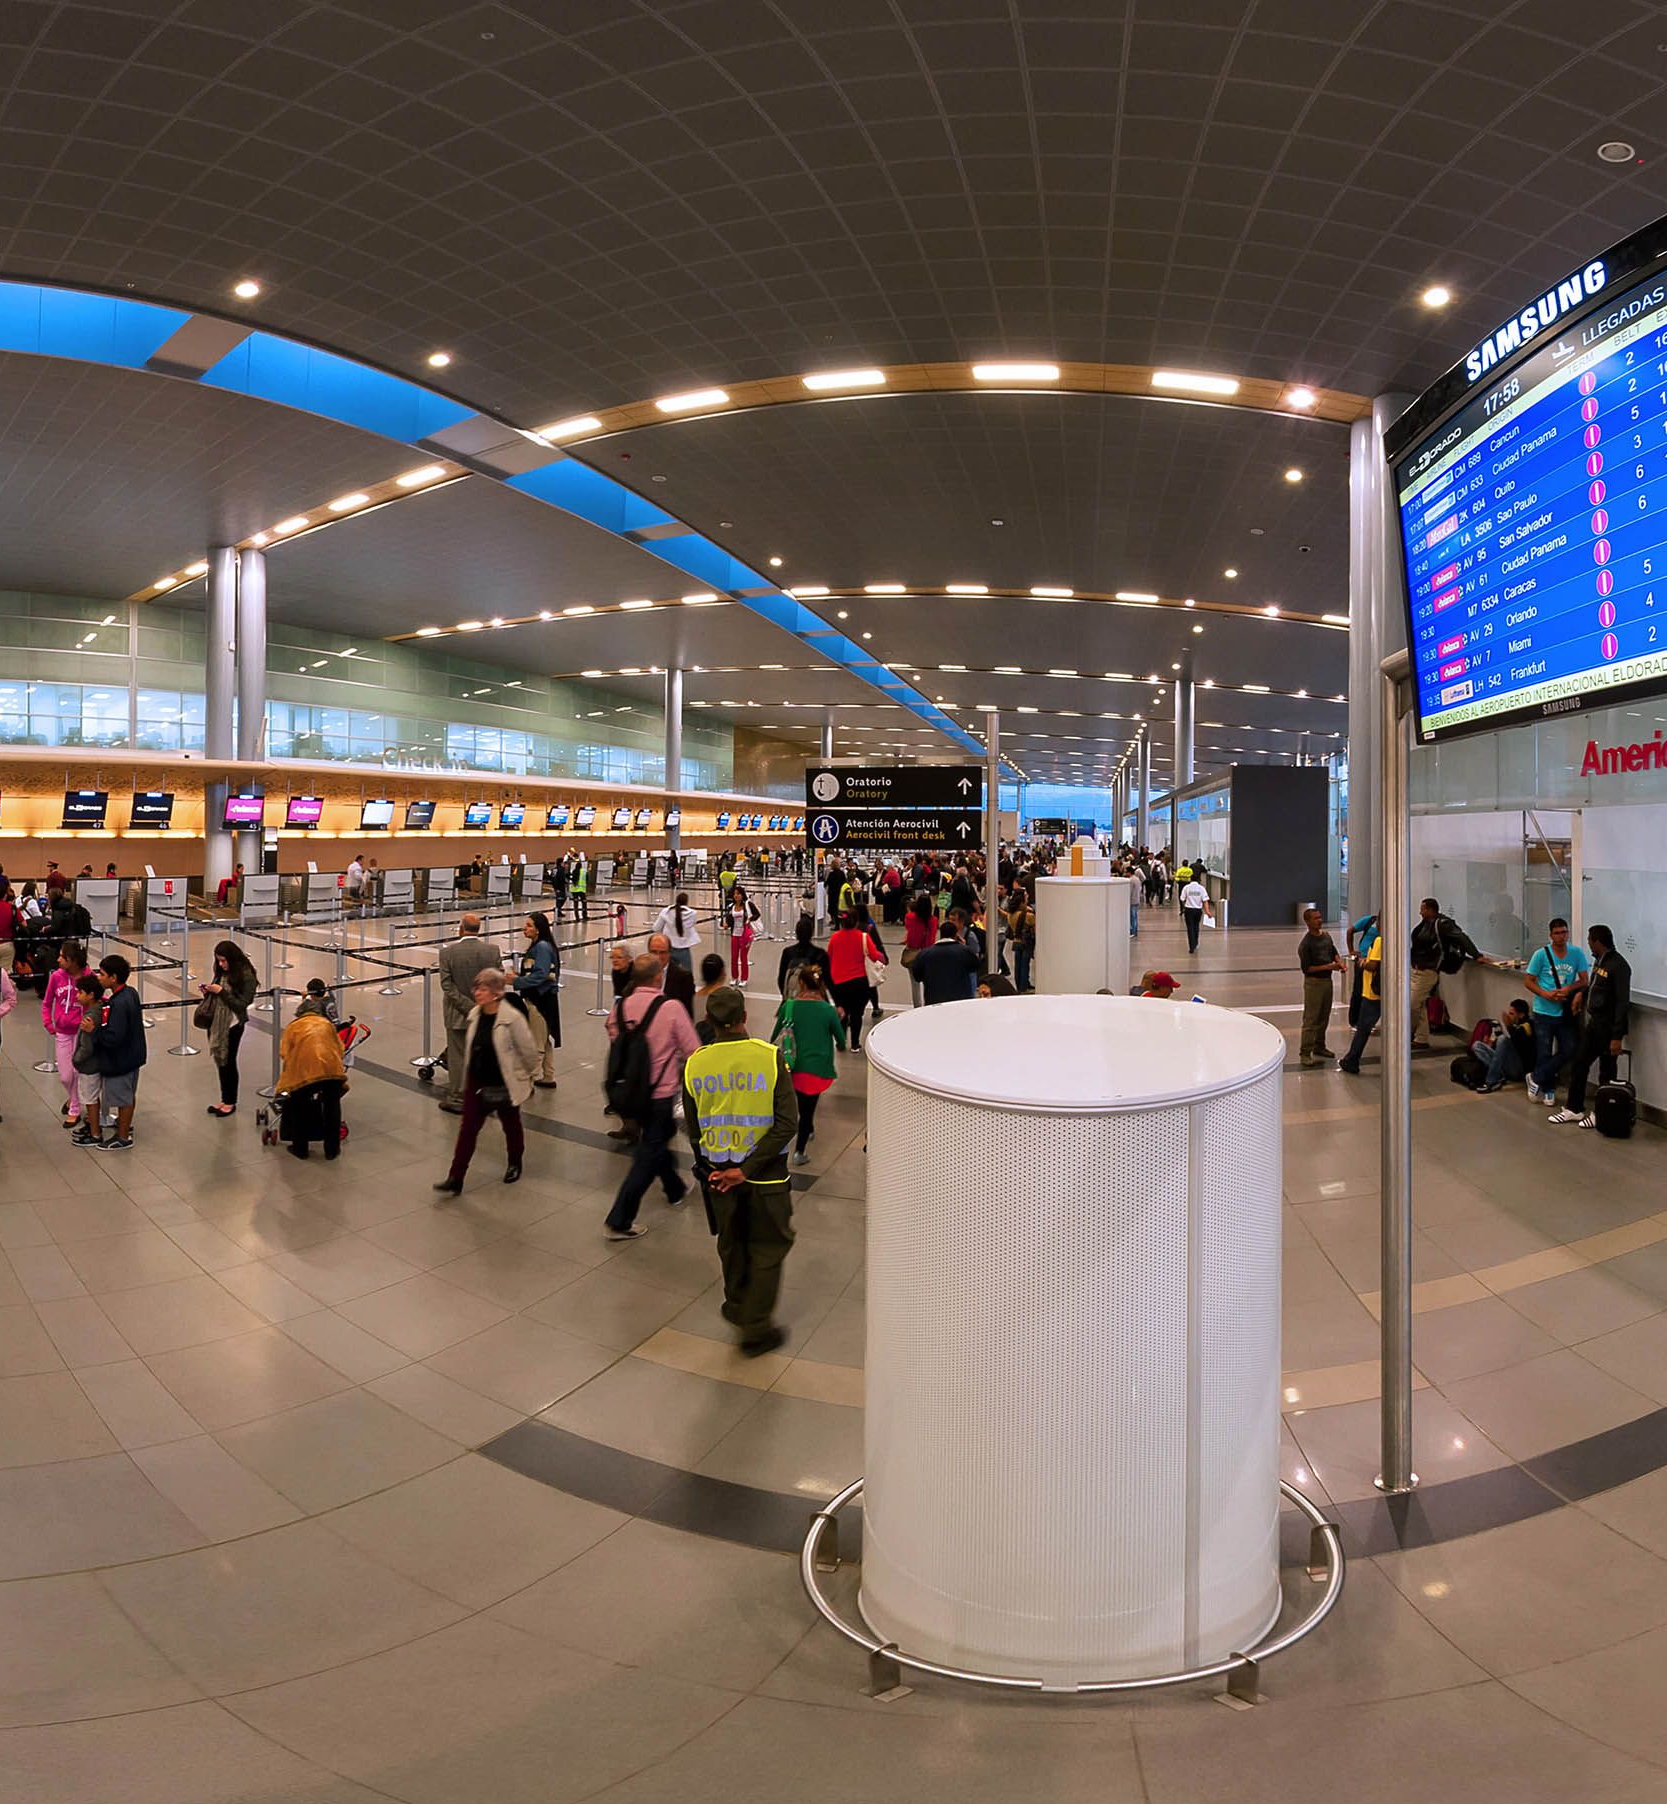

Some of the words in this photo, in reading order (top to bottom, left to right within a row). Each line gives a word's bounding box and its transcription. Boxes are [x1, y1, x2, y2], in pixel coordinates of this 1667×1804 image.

[1467, 261, 1606, 381] SAMSUNG
[1484, 378, 1519, 416] 17:58
[1582, 286, 1665, 346] LLEGADAS
[1490, 426, 1520, 452] Cancun
[1521, 427, 1558, 457] Panama
[1495, 479, 1515, 500] Quito
[1516, 511, 1554, 539] Salvador
[1504, 577, 1537, 601] Caracas
[1510, 660, 1546, 681] Frankfurt
[1533, 673, 1610, 701] INTERNACIONAL
[846, 777, 892, 787] Oratorio
[846, 789, 888, 800] Oratory
[846, 818, 890, 829] Atención
[893, 819, 939, 829] Aerocivil
[846, 830, 890, 839] Aerocivil
[893, 830, 919, 840] front
[922, 830, 945, 840] desk
[692, 1071, 767, 1094] POLICIA
